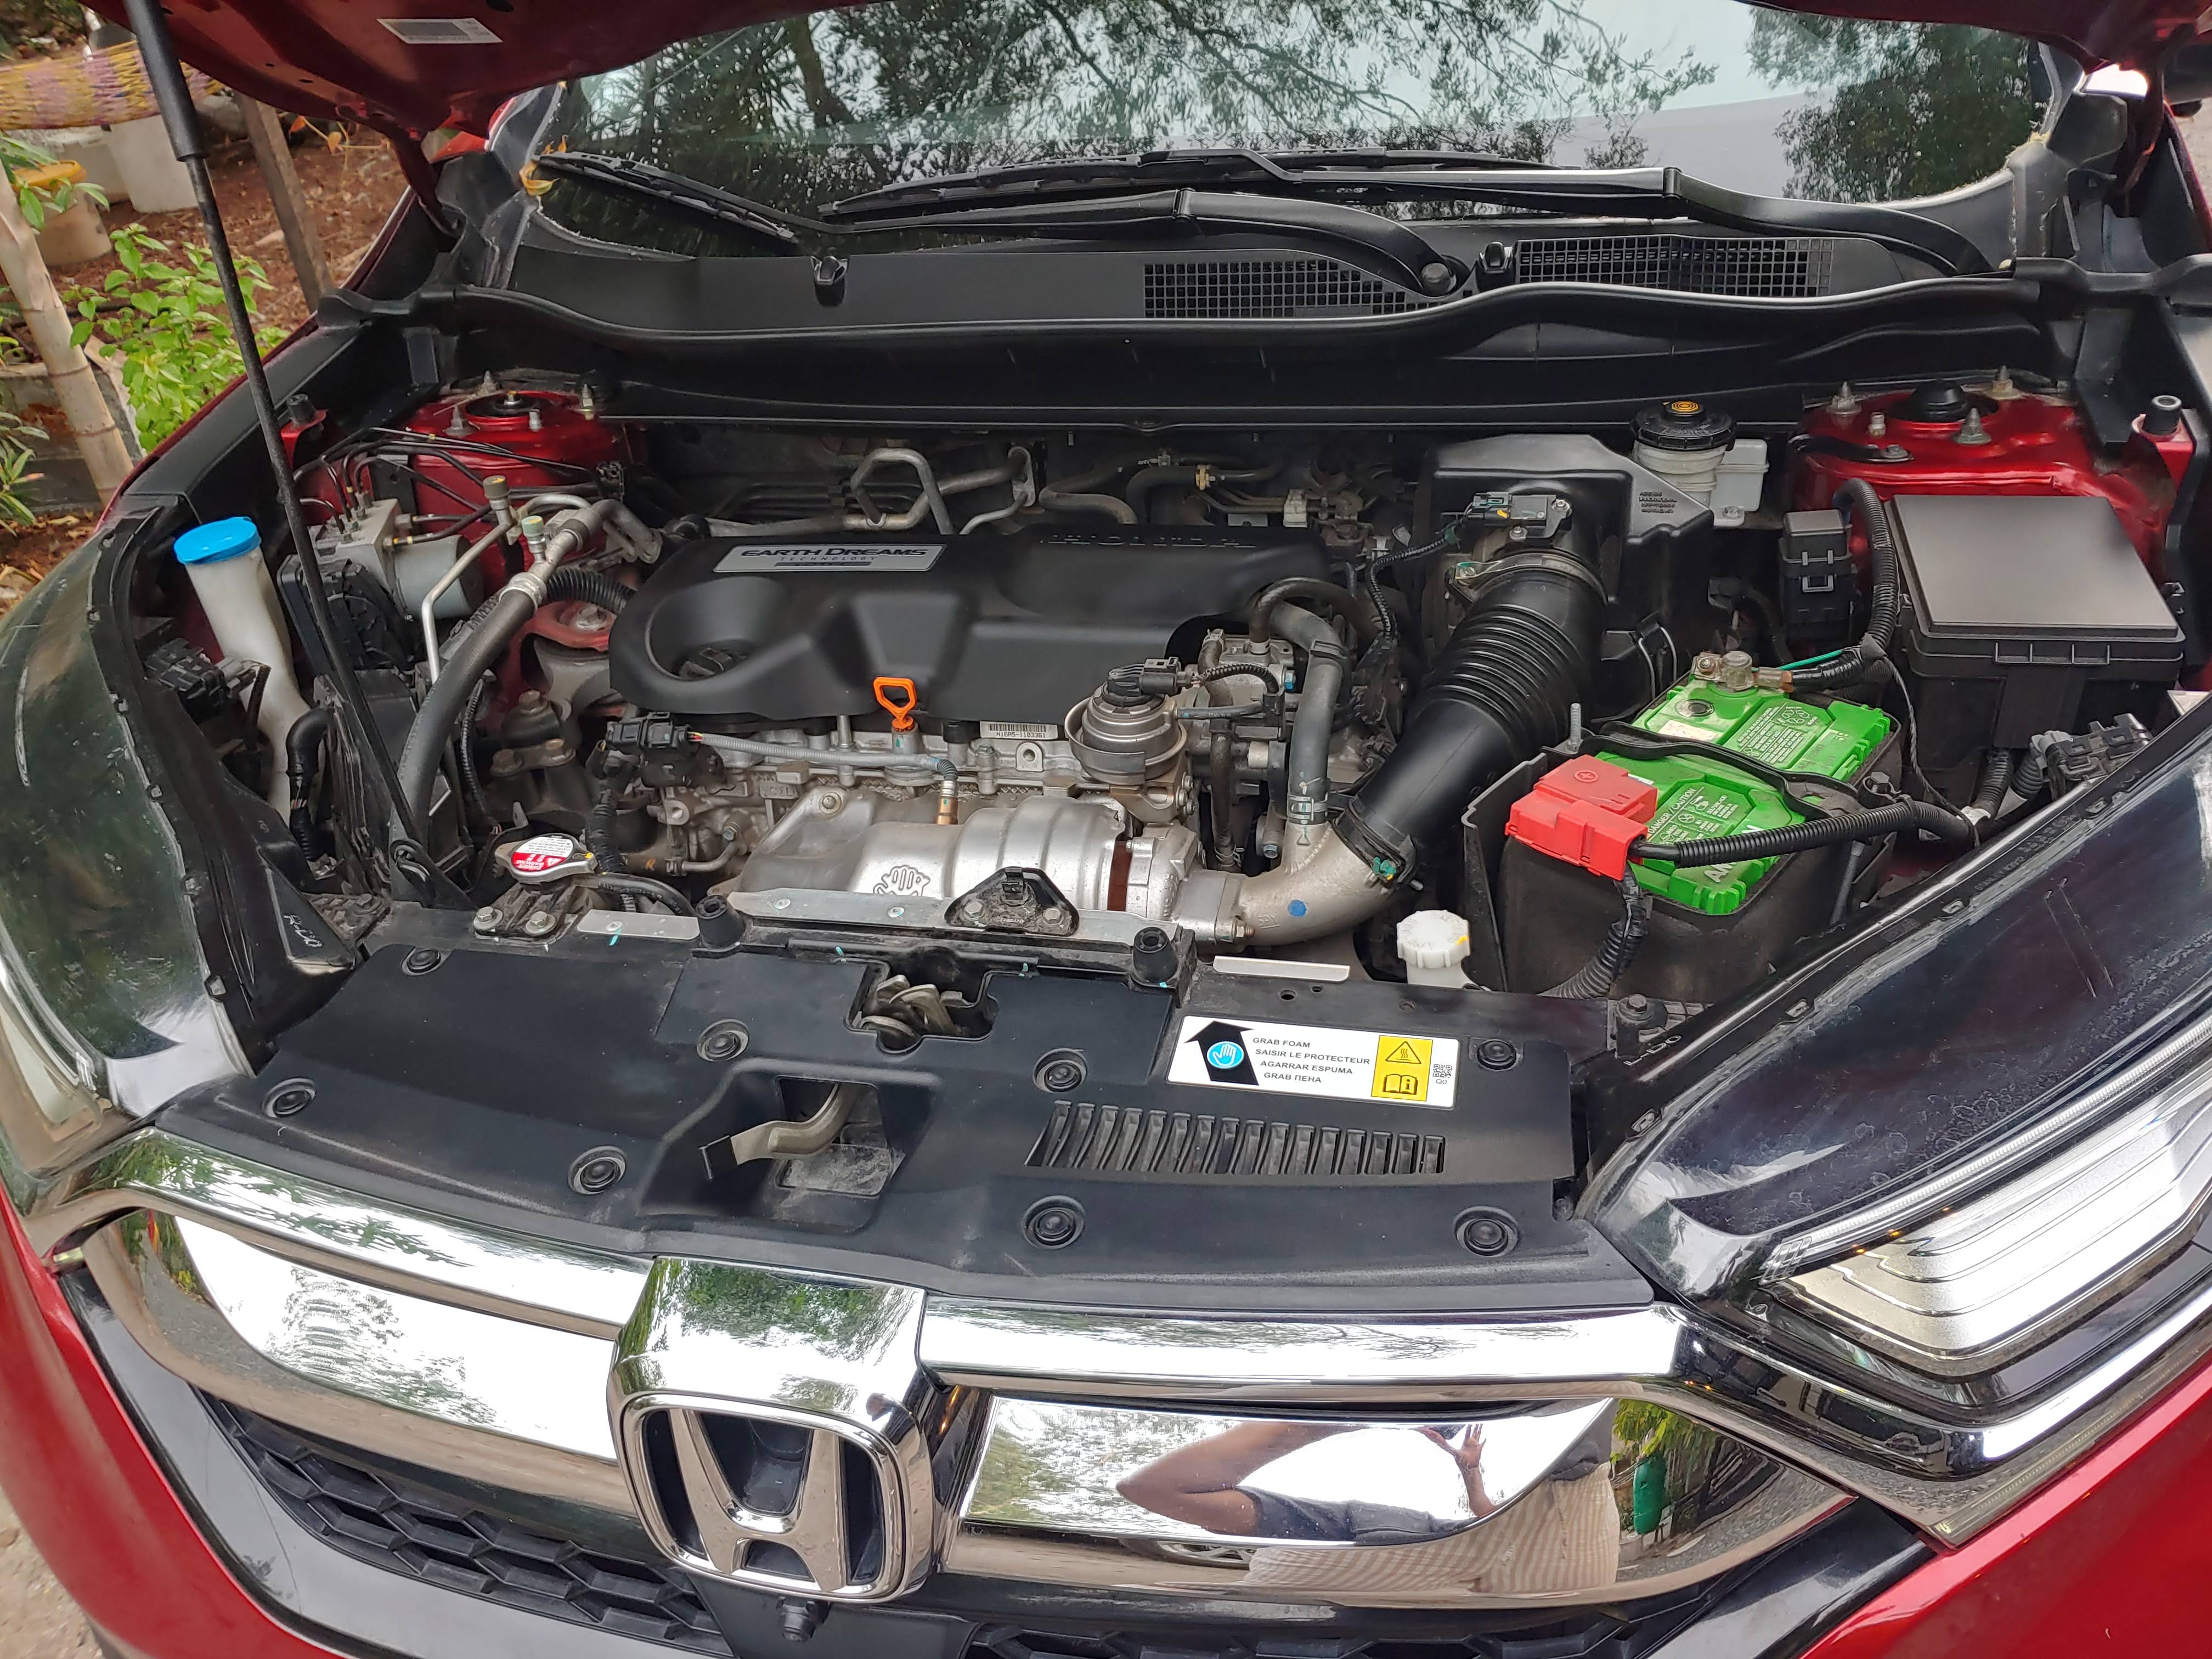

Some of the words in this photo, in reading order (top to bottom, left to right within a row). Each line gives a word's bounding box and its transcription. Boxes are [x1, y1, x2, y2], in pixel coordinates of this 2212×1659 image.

[825, 548, 928, 556] DREAMS
[1673, 788, 1697, 810] CAUTION
[1304, 1053, 1370, 1064] PROTECTEUR
[1260, 1060, 1309, 1070] AGARRAR
[1312, 1065, 1353, 1074] ESPUMA
[1264, 1072, 1291, 1080] GRAB
